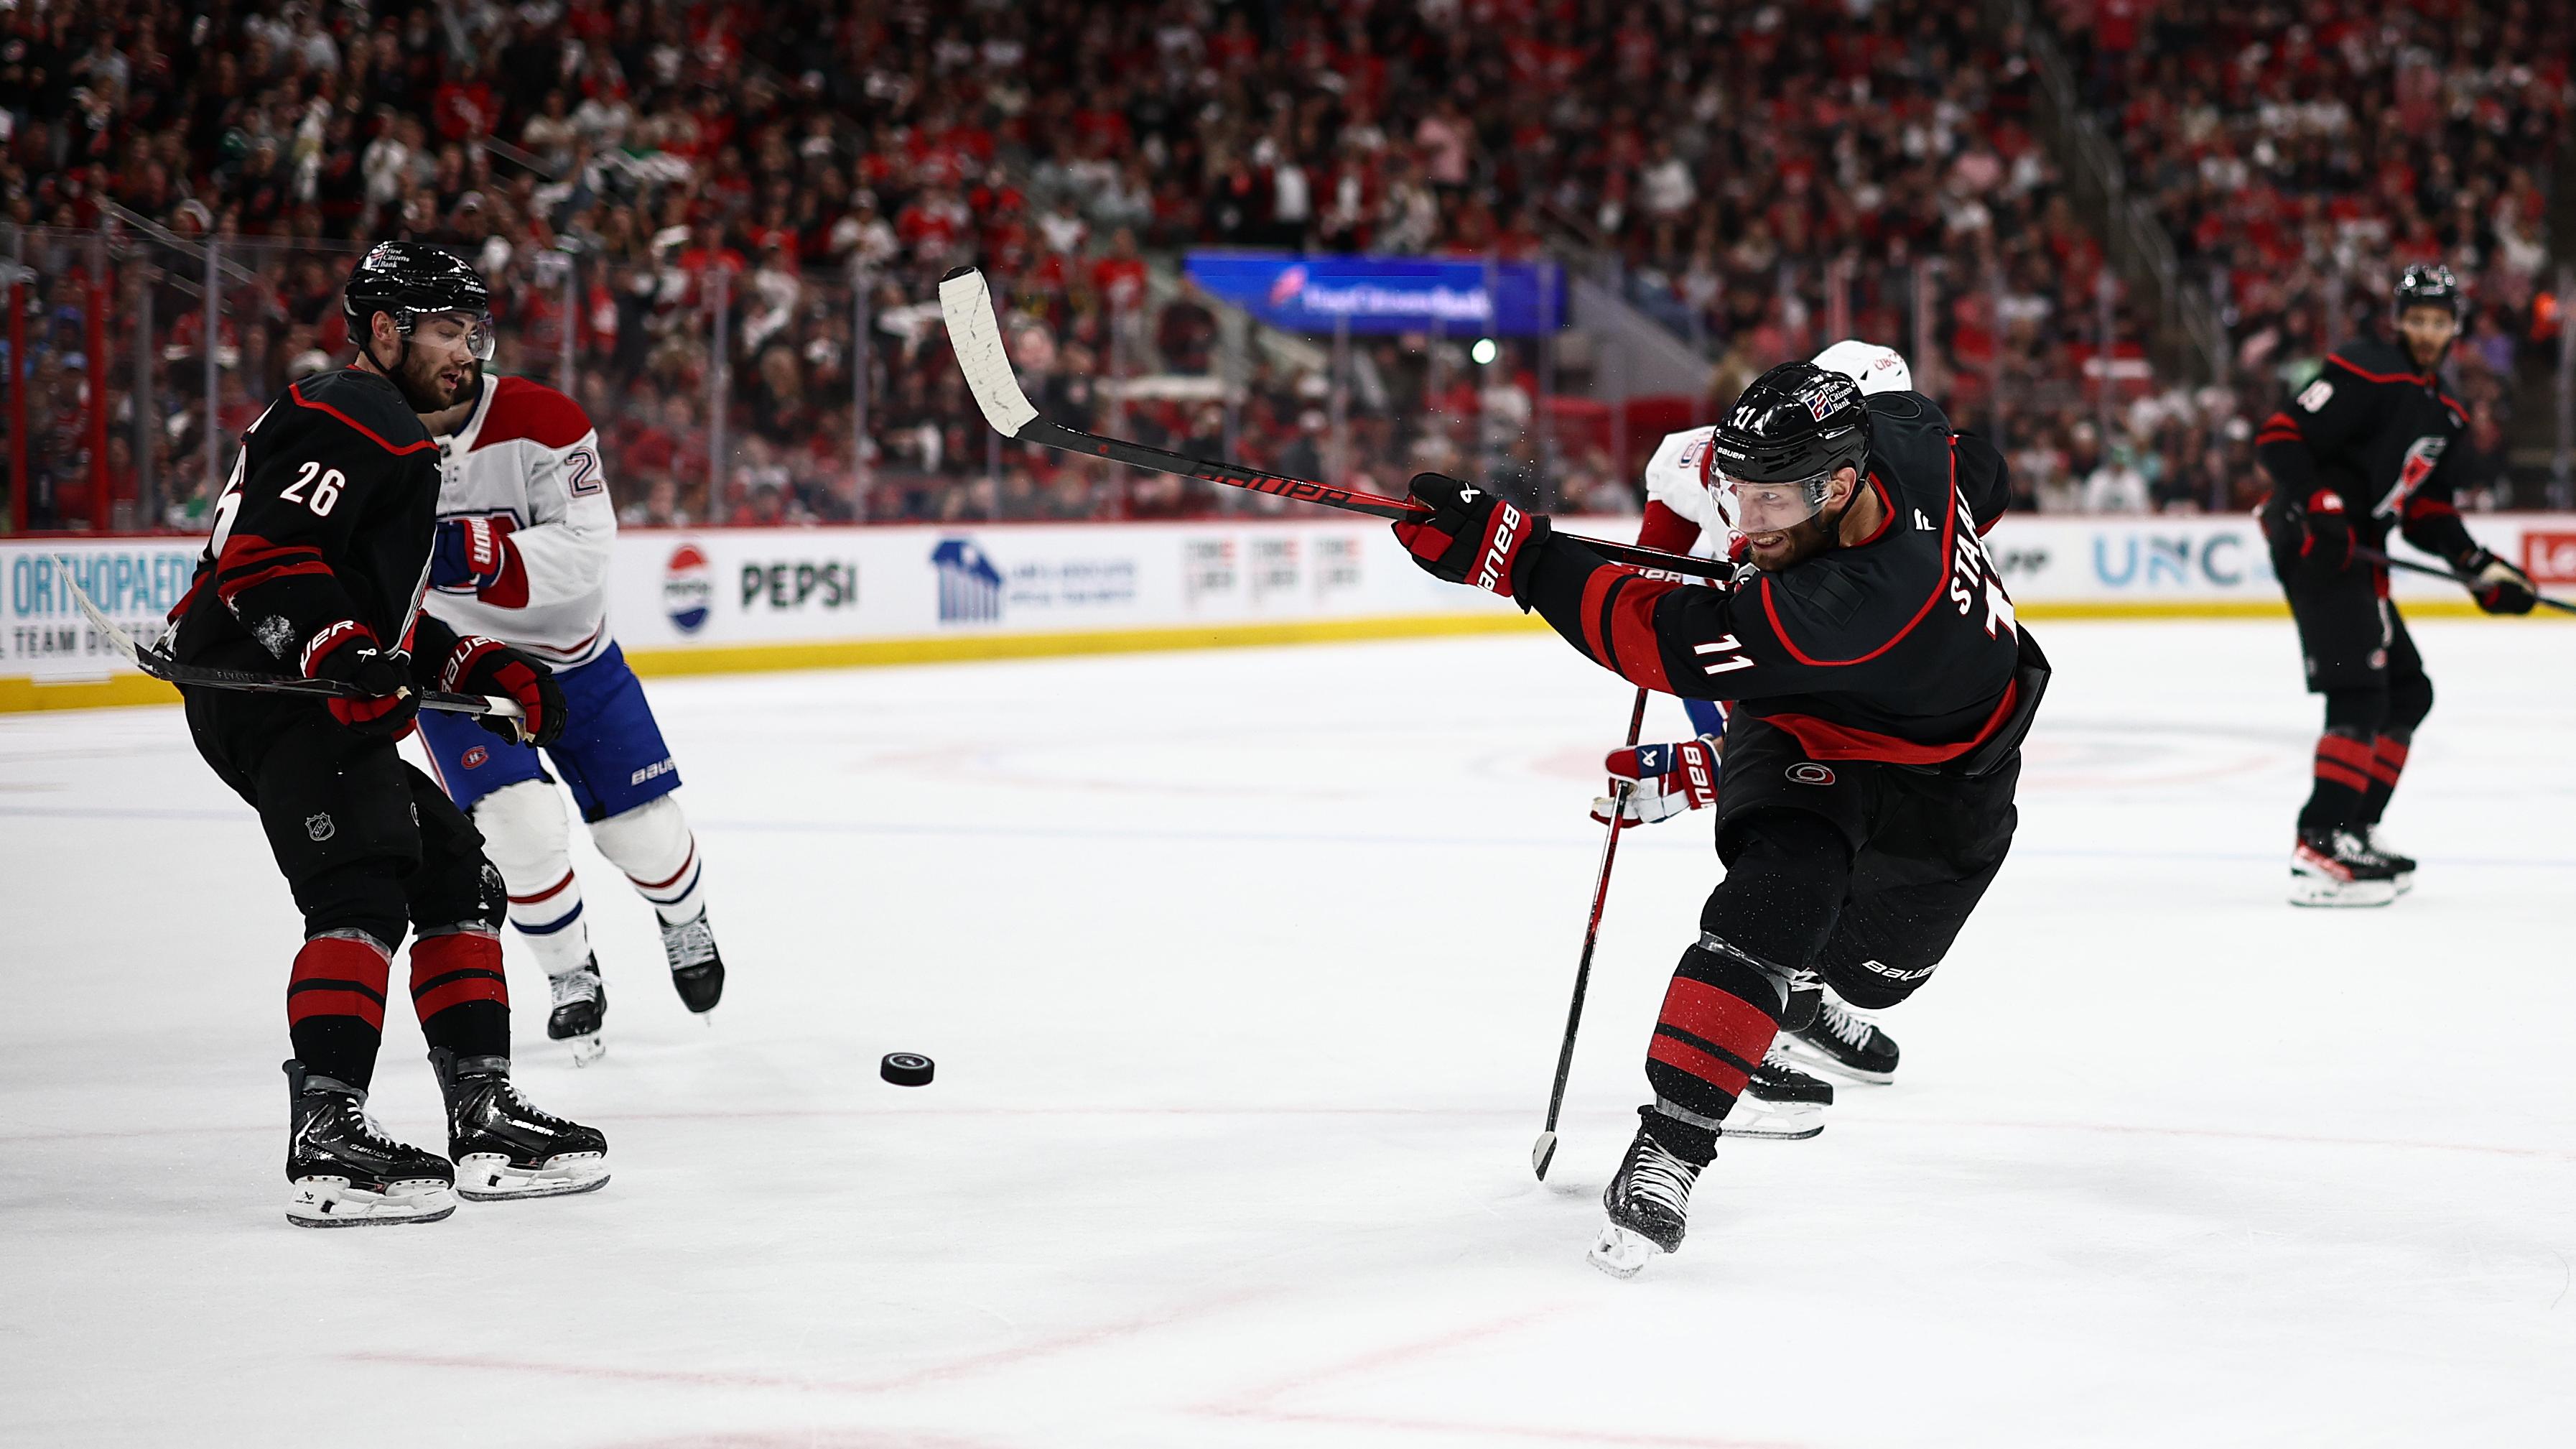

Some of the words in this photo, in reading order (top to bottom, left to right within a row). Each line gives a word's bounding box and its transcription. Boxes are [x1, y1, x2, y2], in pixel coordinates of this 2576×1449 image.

[1824, 382, 1840, 395] First
[1828, 386, 1854, 403] Citizens
[1833, 397, 1851, 412] Bank
[279, 460, 346, 517] 26
[1477, 503, 1520, 591] BAUE
[2093, 534, 2243, 586] UNC
[740, 563, 858, 608] PEPSI
[1693, 633, 1756, 675] 11
[631, 756, 675, 787] BAUE
